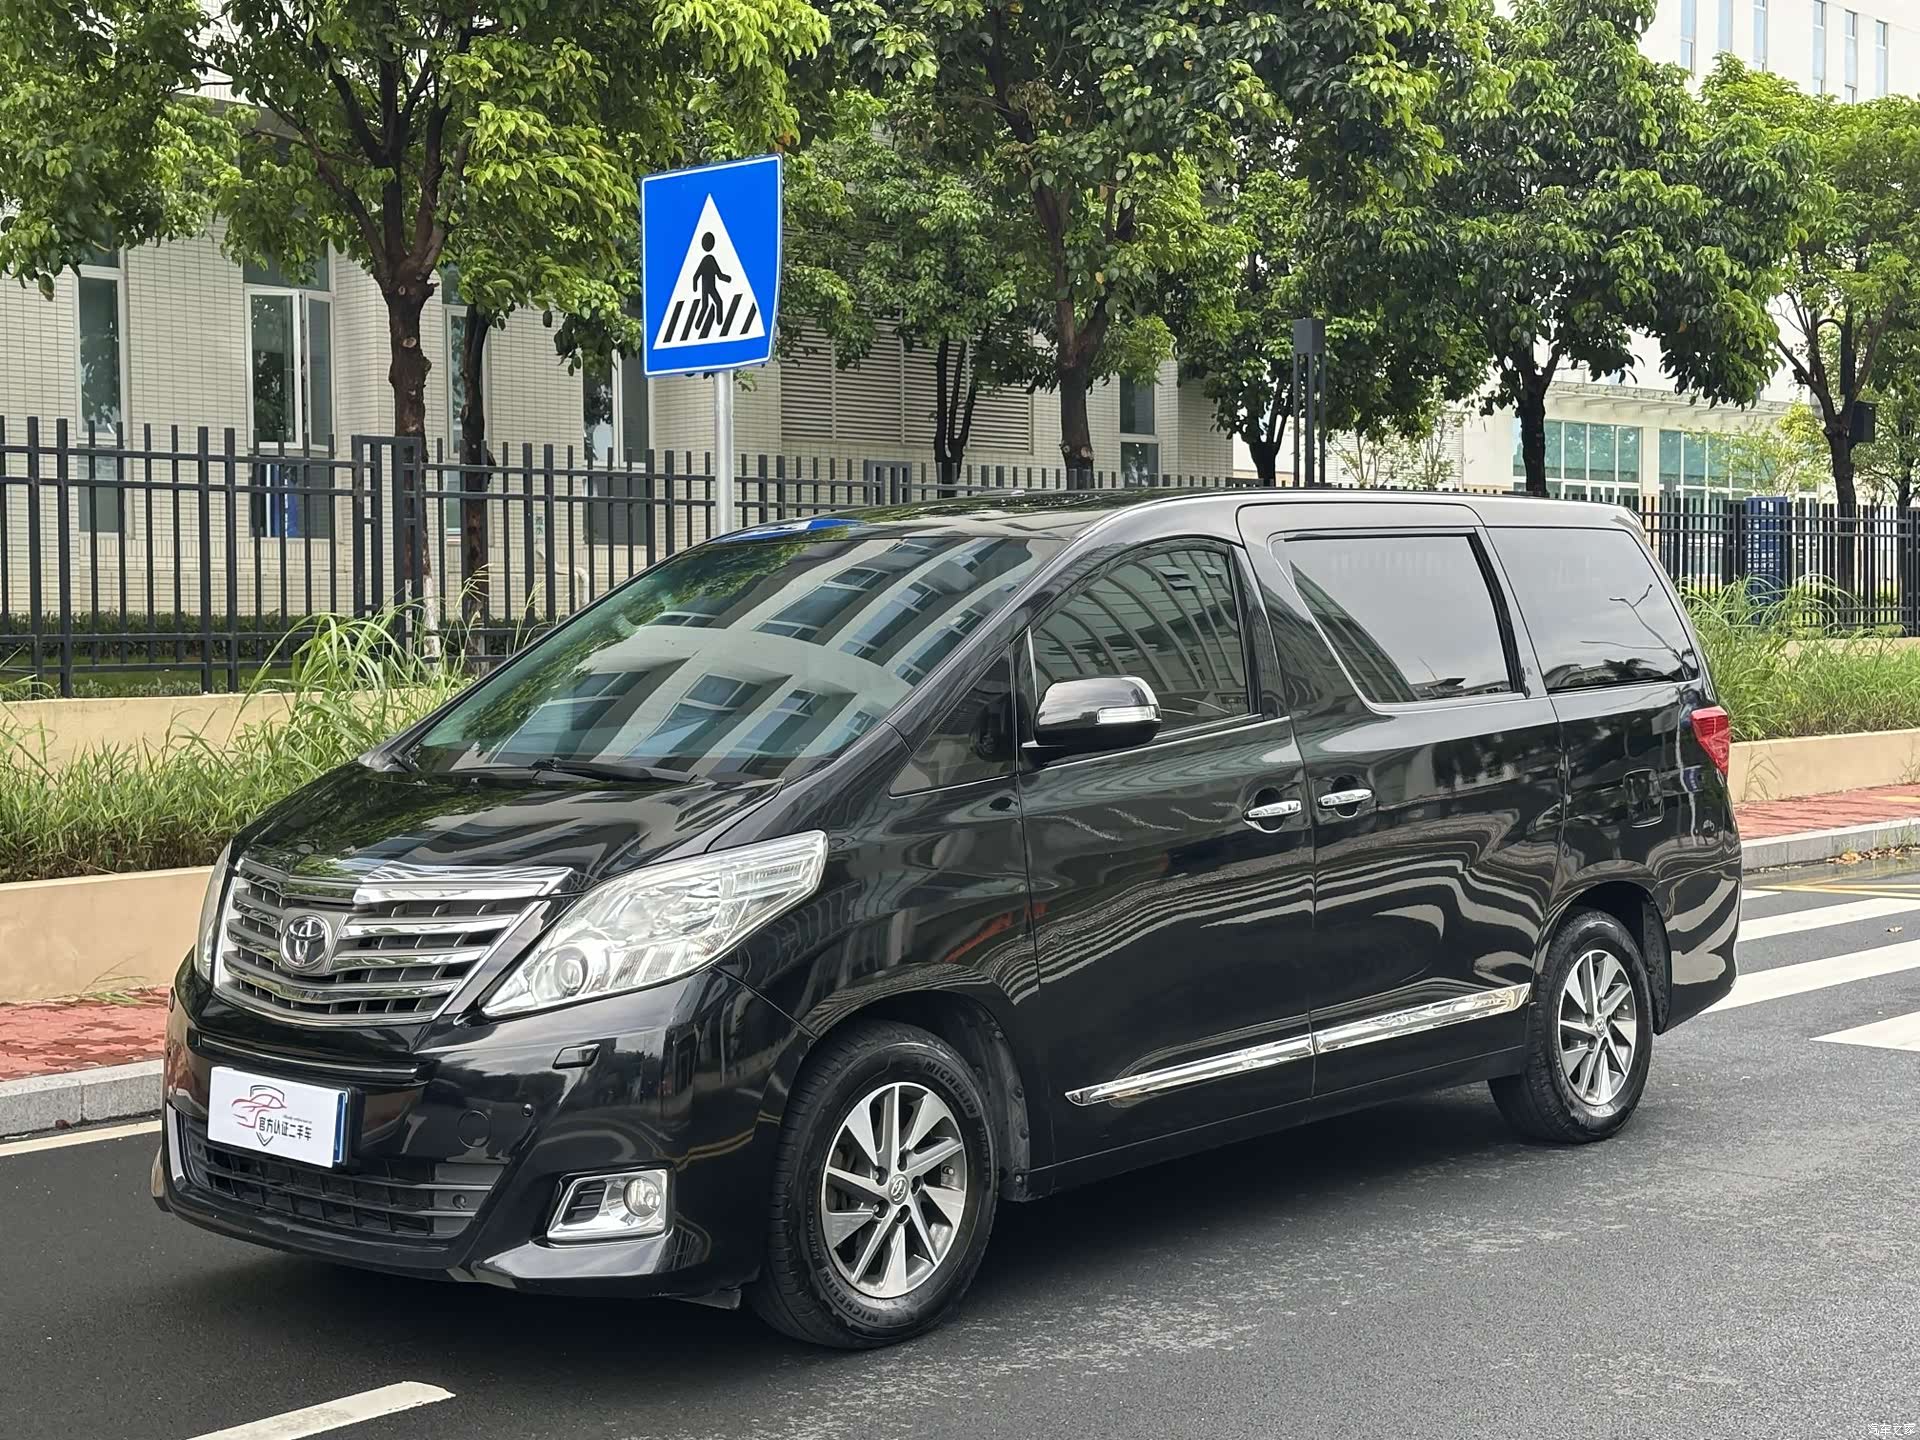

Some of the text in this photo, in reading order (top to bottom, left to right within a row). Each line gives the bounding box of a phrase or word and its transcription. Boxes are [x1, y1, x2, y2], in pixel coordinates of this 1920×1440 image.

[922, 1060, 978, 1116] MICHELIN
[259, 1116, 313, 1141] 官方认证二手车
[823, 1268, 880, 1324] MICHELIN
